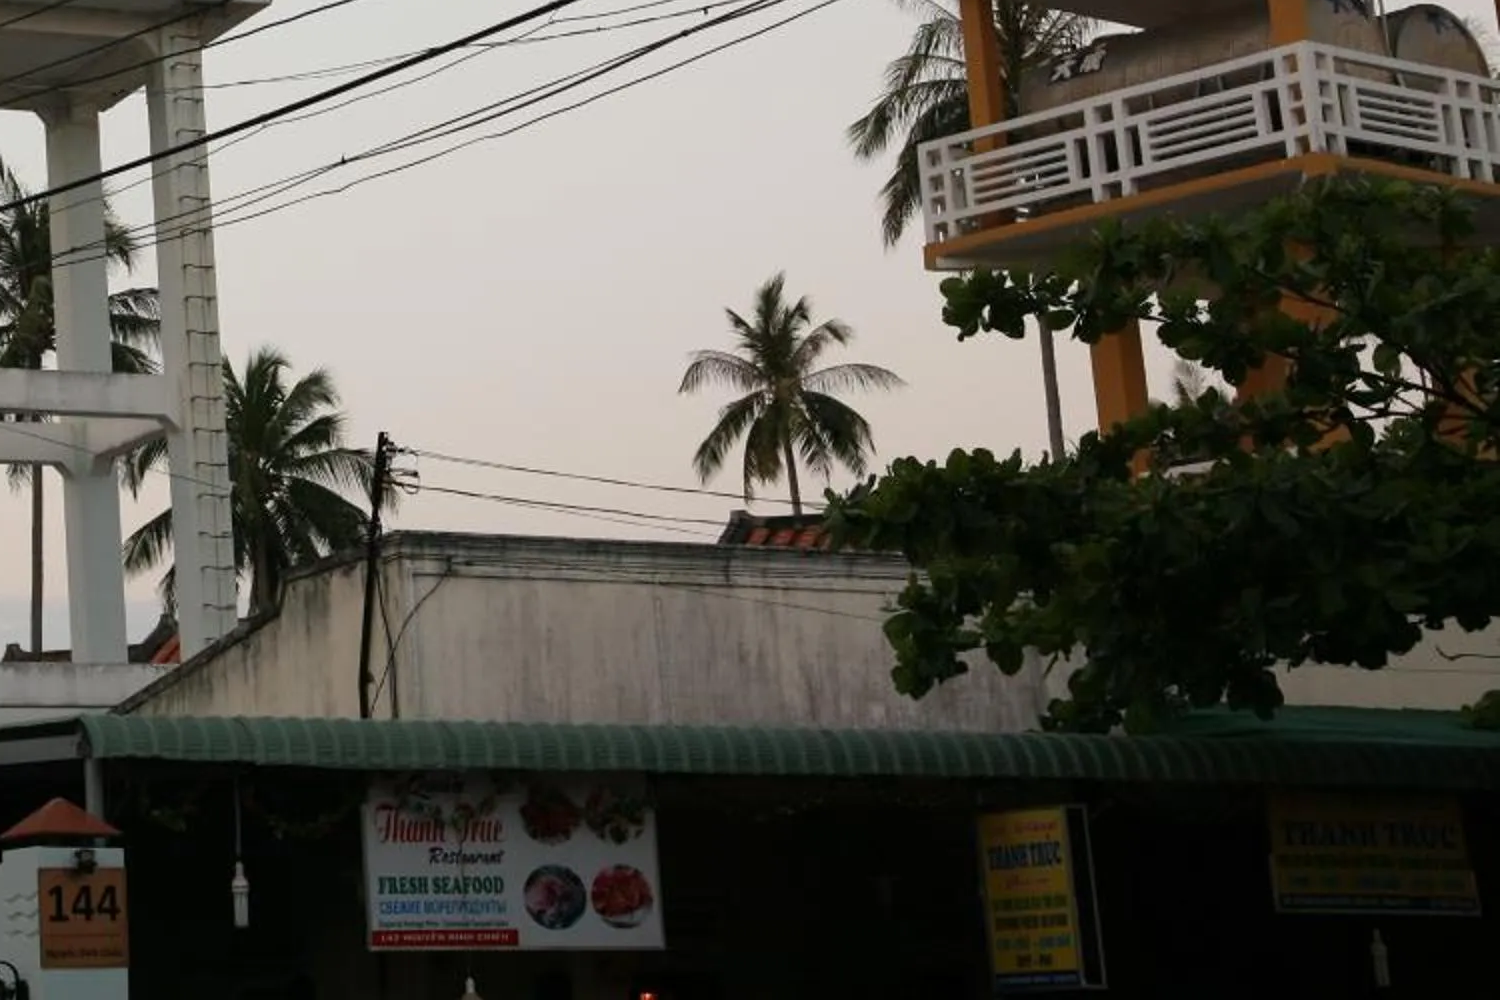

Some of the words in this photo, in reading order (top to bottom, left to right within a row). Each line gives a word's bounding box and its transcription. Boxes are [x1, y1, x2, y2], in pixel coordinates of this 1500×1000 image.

[428, 847, 506, 865] Restaurant
[378, 876, 429, 895] FRESH
[431, 875, 506, 895] SEAFOOD
[48, 885, 122, 922] 144
